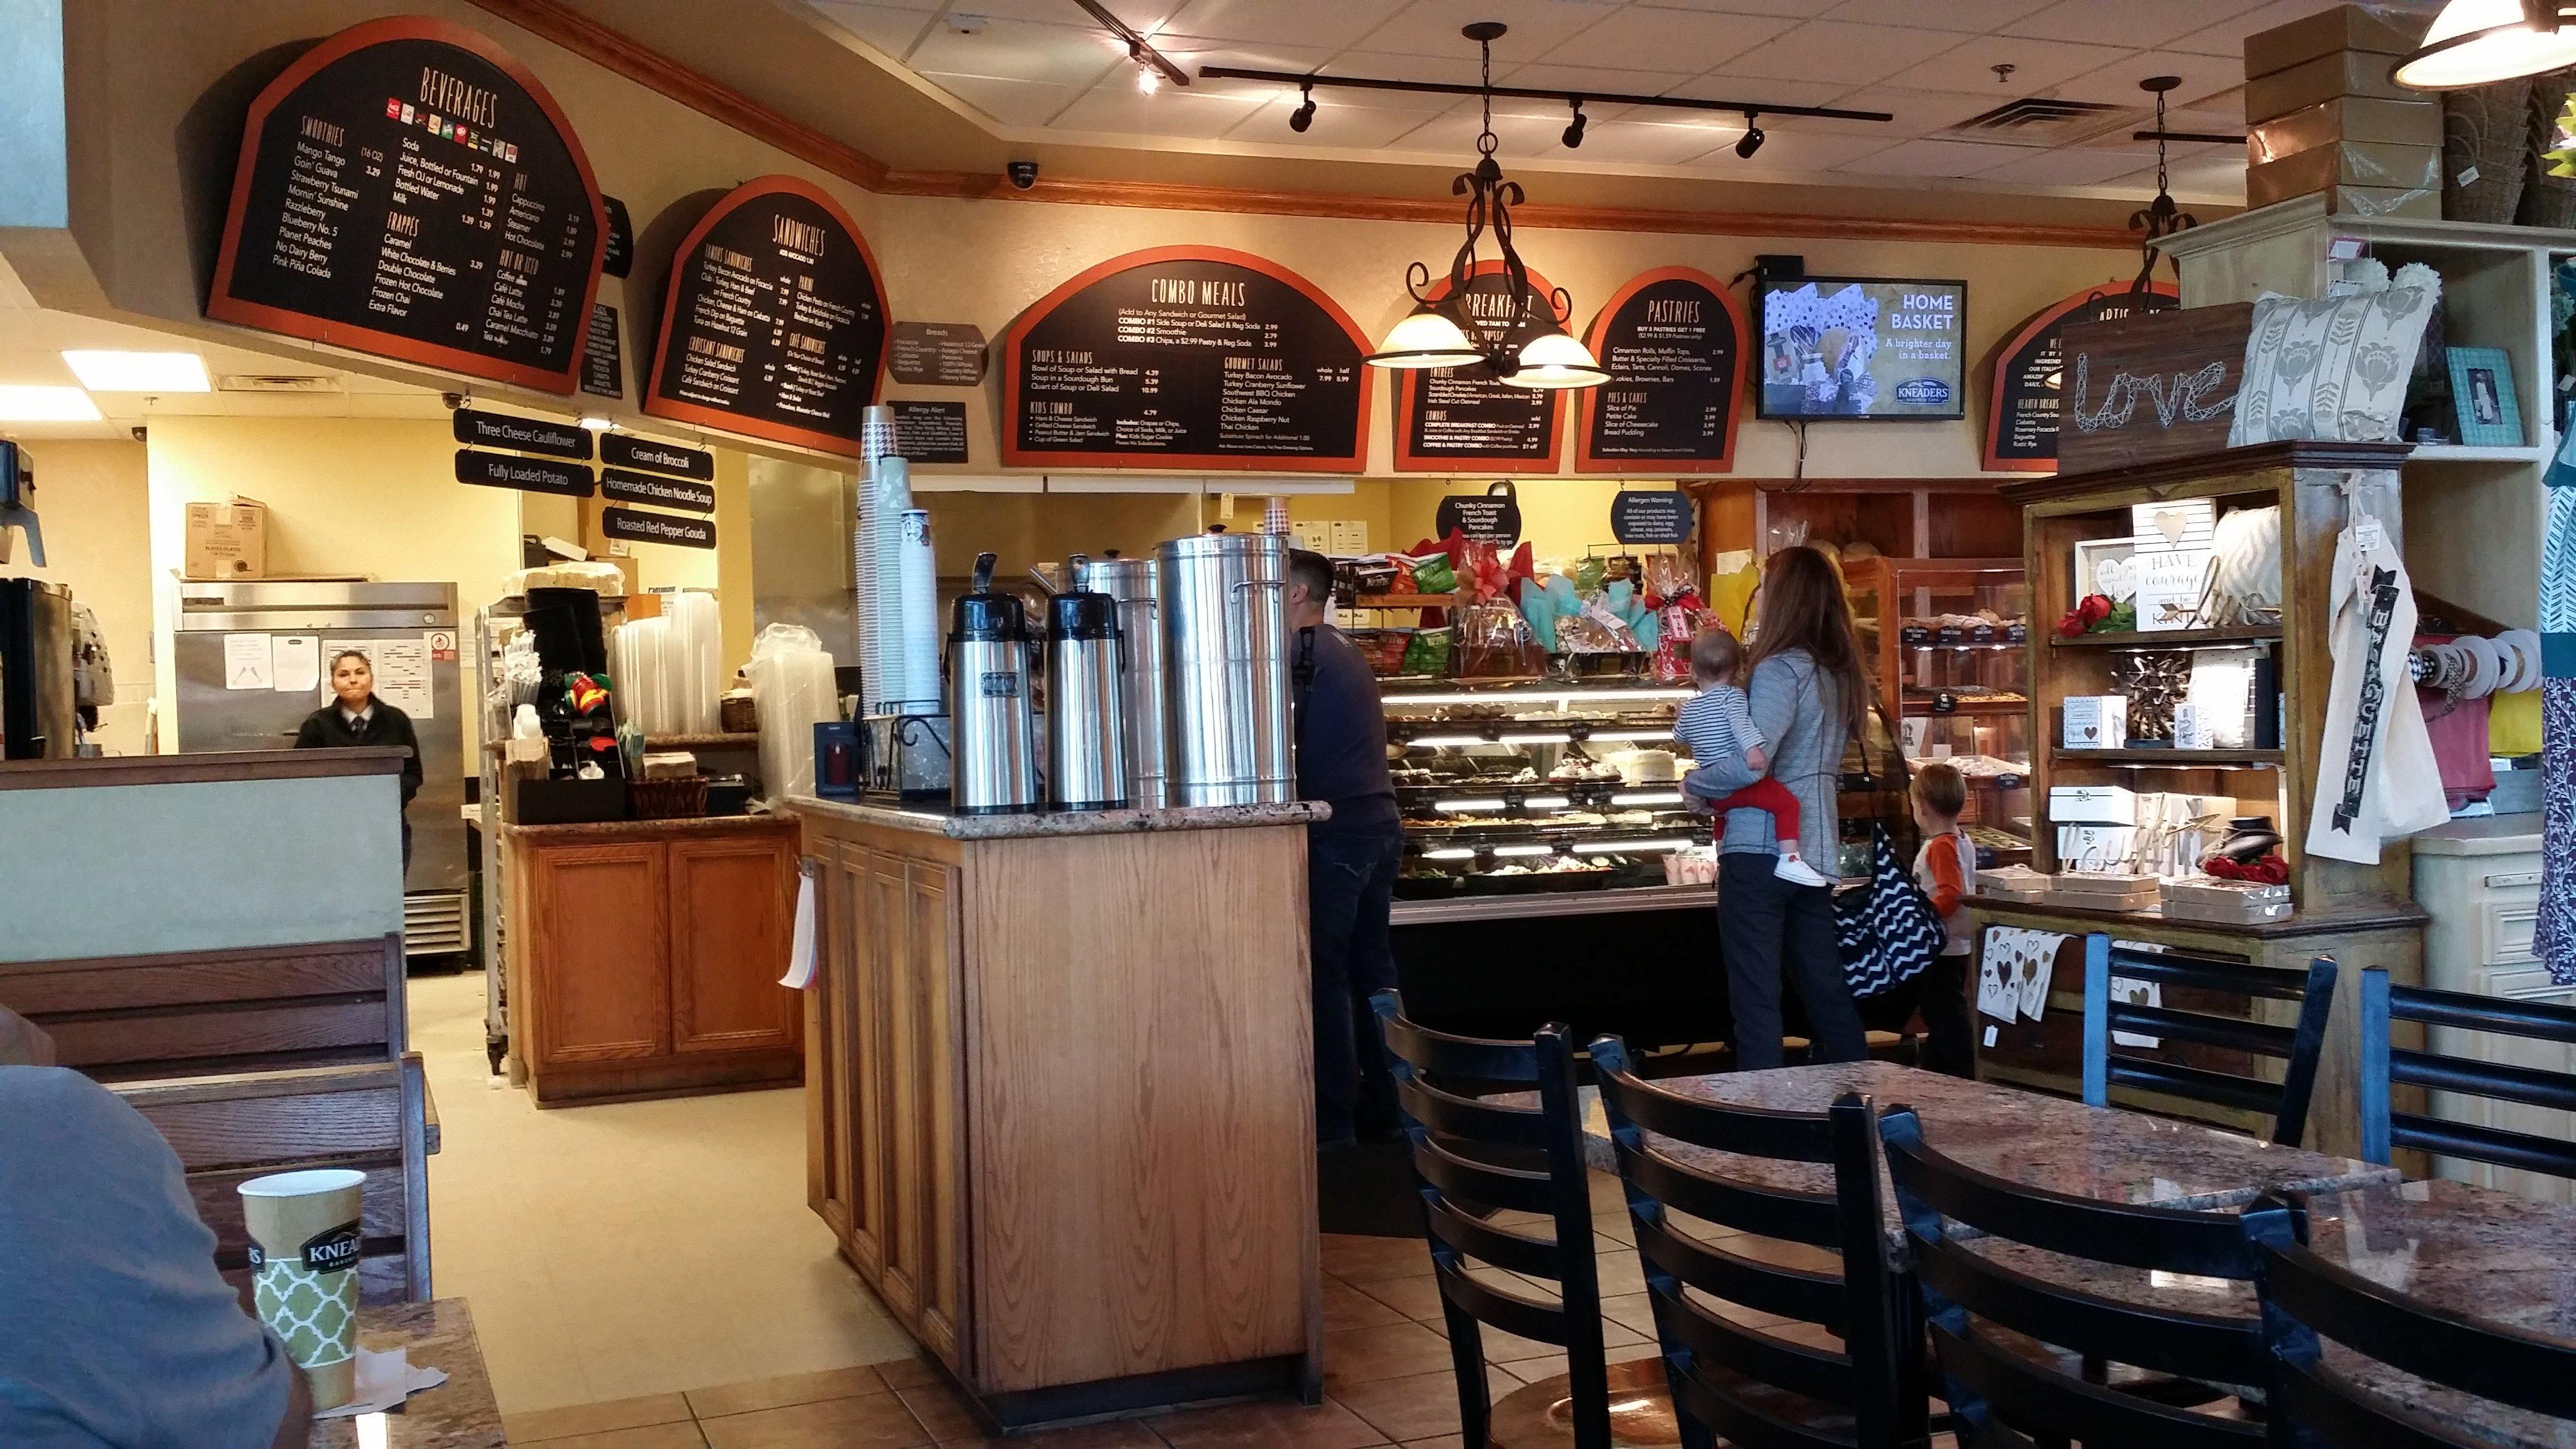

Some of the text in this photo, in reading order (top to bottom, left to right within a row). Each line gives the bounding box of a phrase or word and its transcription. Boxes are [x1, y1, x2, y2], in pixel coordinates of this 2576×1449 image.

[420, 67, 497, 129] BEVERAGES
[301, 115, 344, 147] SMOOTHIES
[402, 137, 419, 152] Soda
[297, 141, 346, 167] Mango Tango
[315, 163, 338, 178] Guava
[291, 169, 359, 200] Strawberry Tsunami
[395, 178, 440, 200] Bottled Water
[288, 184, 348, 211] Mornin' Sunshine
[393, 192, 406, 204] Milk
[512, 193, 545, 212] Cappuccino
[285, 198, 326, 220] Razzleberry
[279, 227, 332, 250] Planet Peaches
[384, 233, 412, 249] Caramel
[772, 214, 825, 256] SANDWICHES
[273, 254, 287, 267] Pink
[306, 263, 331, 278] Colada
[378, 260, 436, 283] Double Chocolate
[372, 286, 411, 304] Frozen Chai
[375, 273, 444, 299] Frozen Hot Chocolate
[1152, 279, 1245, 306] COMBO MEALS
[1466, 293, 1533, 318] BREAKFT
[1647, 300, 1700, 323] PASTRIES
[1903, 294, 1953, 311] HOME
[1144, 310, 1157, 318] Any
[1198, 312, 1226, 320] Gourmet
[1892, 313, 1953, 329] BASKET
[1886, 338, 1952, 350] A brighter day
[1032, 350, 1055, 363] SOUPS
[1066, 351, 1092, 364] SALADS
[1225, 357, 1282, 371] GOURMET SALADS
[1900, 351, 1908, 359] in
[1918, 351, 1951, 359] basket.
[1058, 366, 1075, 374] Soup
[1224, 371, 1244, 380] Turkey
[1224, 380, 1244, 389] Turkey
[1245, 381, 1275, 389] Cranberry
[1898, 388, 1948, 399] KNEADERS
[1608, 393, 1647, 403] PIES CAKES
[1030, 402, 1072, 414] KIDS COMBO
[1247, 416, 1277, 424] Raspberry
[476, 421, 576, 448] Three Cheese Cauliflower
[632, 448, 690, 469] Cream of Broccoli
[489, 464, 568, 485] Fully Loaded Potato
[607, 477, 711, 505] Homemade Chicken Noodle Soup
[617, 517, 706, 540] Roasted Red Pepper Gouda
[2152, 554, 2196, 570] HAVE
[2145, 574, 2198, 591] courage
